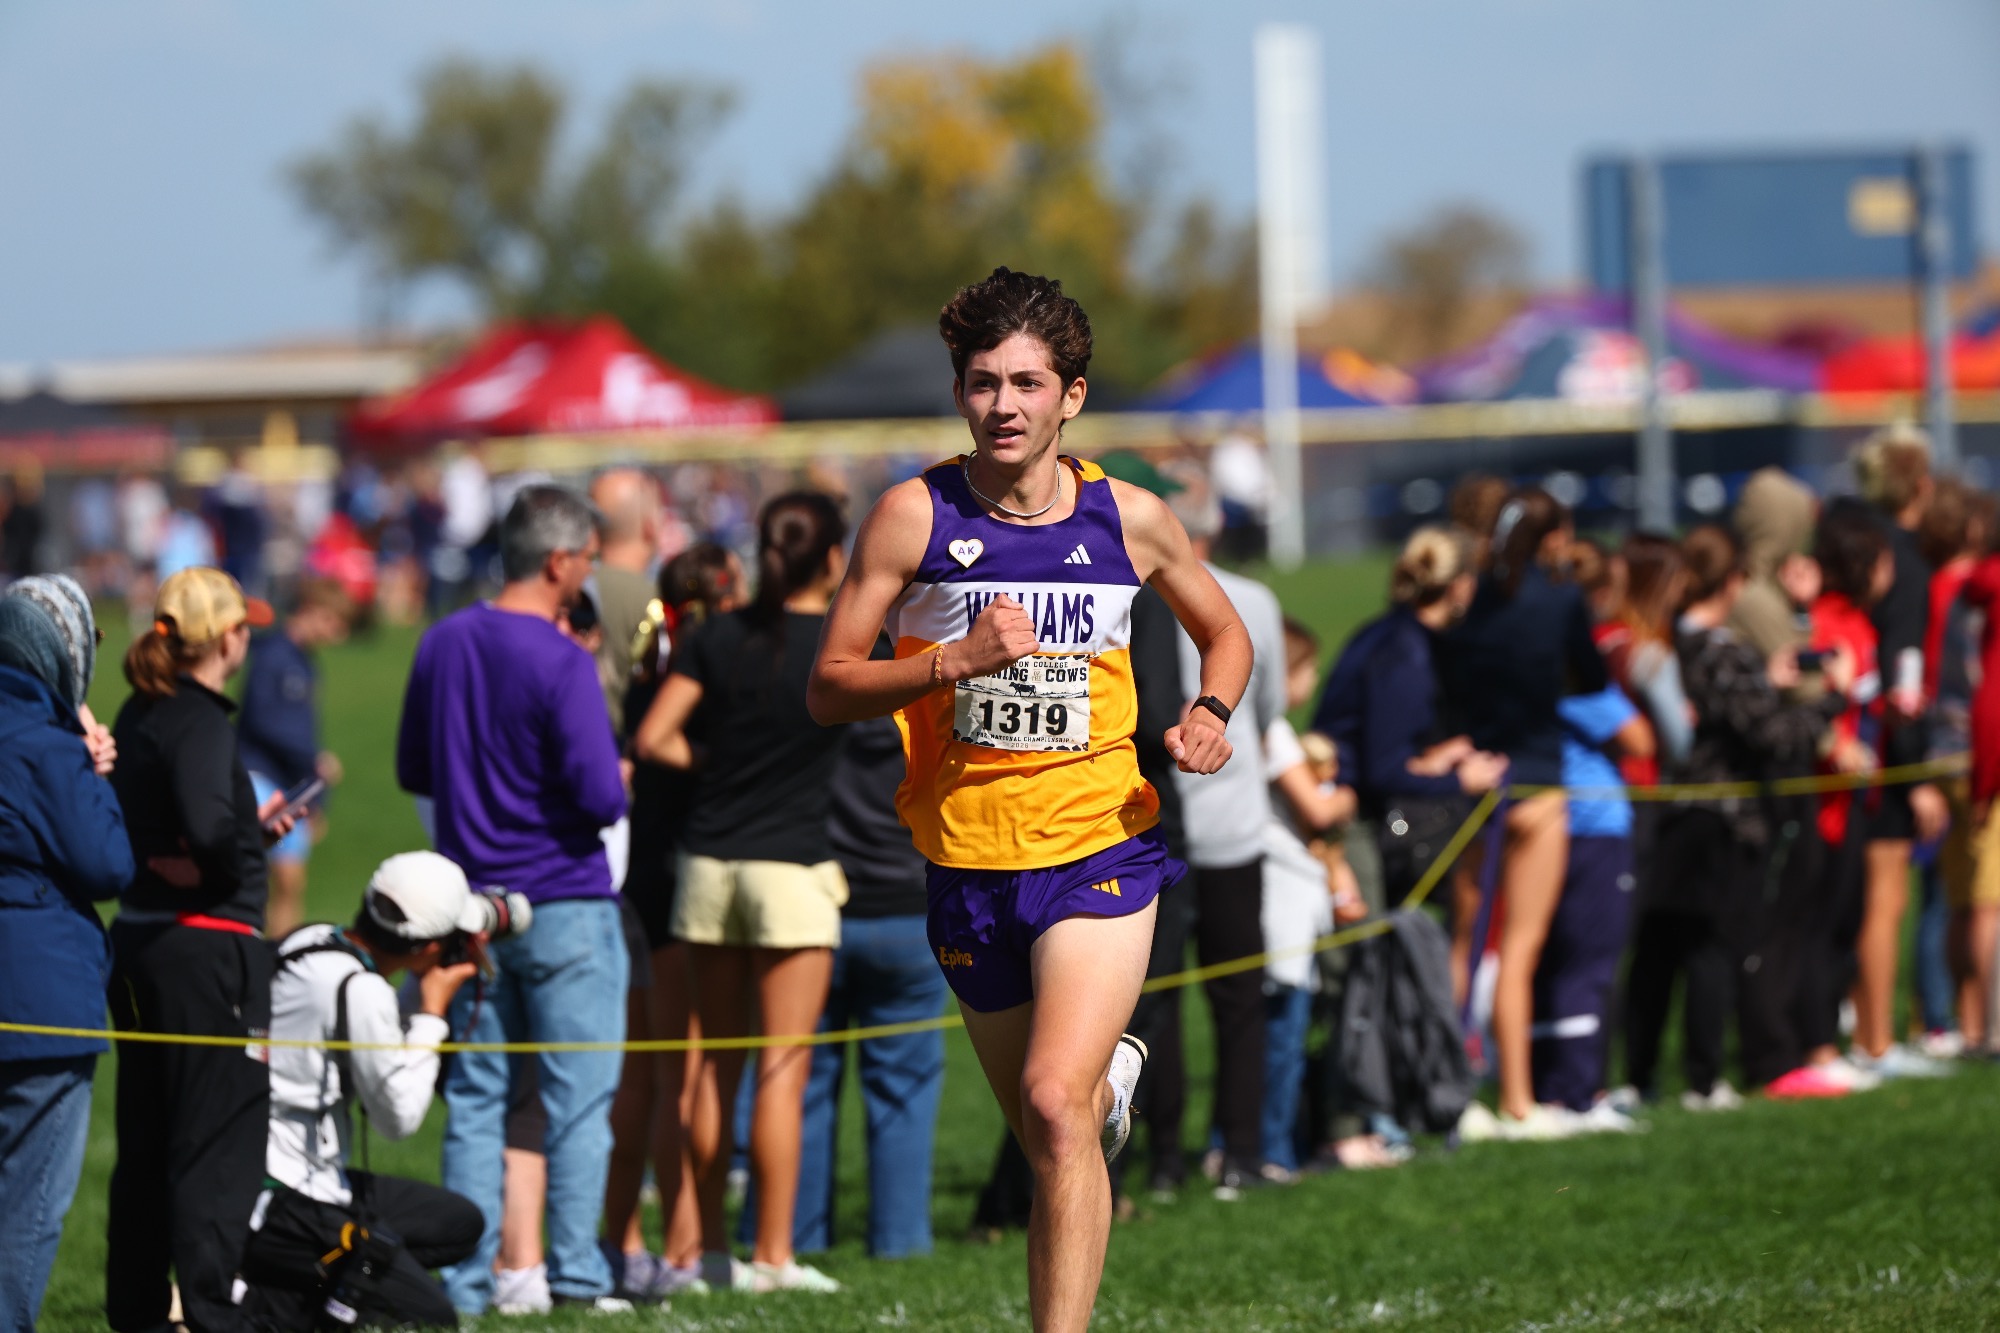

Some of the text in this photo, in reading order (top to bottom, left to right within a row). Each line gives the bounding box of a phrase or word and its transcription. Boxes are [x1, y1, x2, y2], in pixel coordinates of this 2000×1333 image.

[1045, 667, 1087, 682] COWS
[978, 699, 1068, 736] 1319
[939, 946, 973, 971] Ephs
